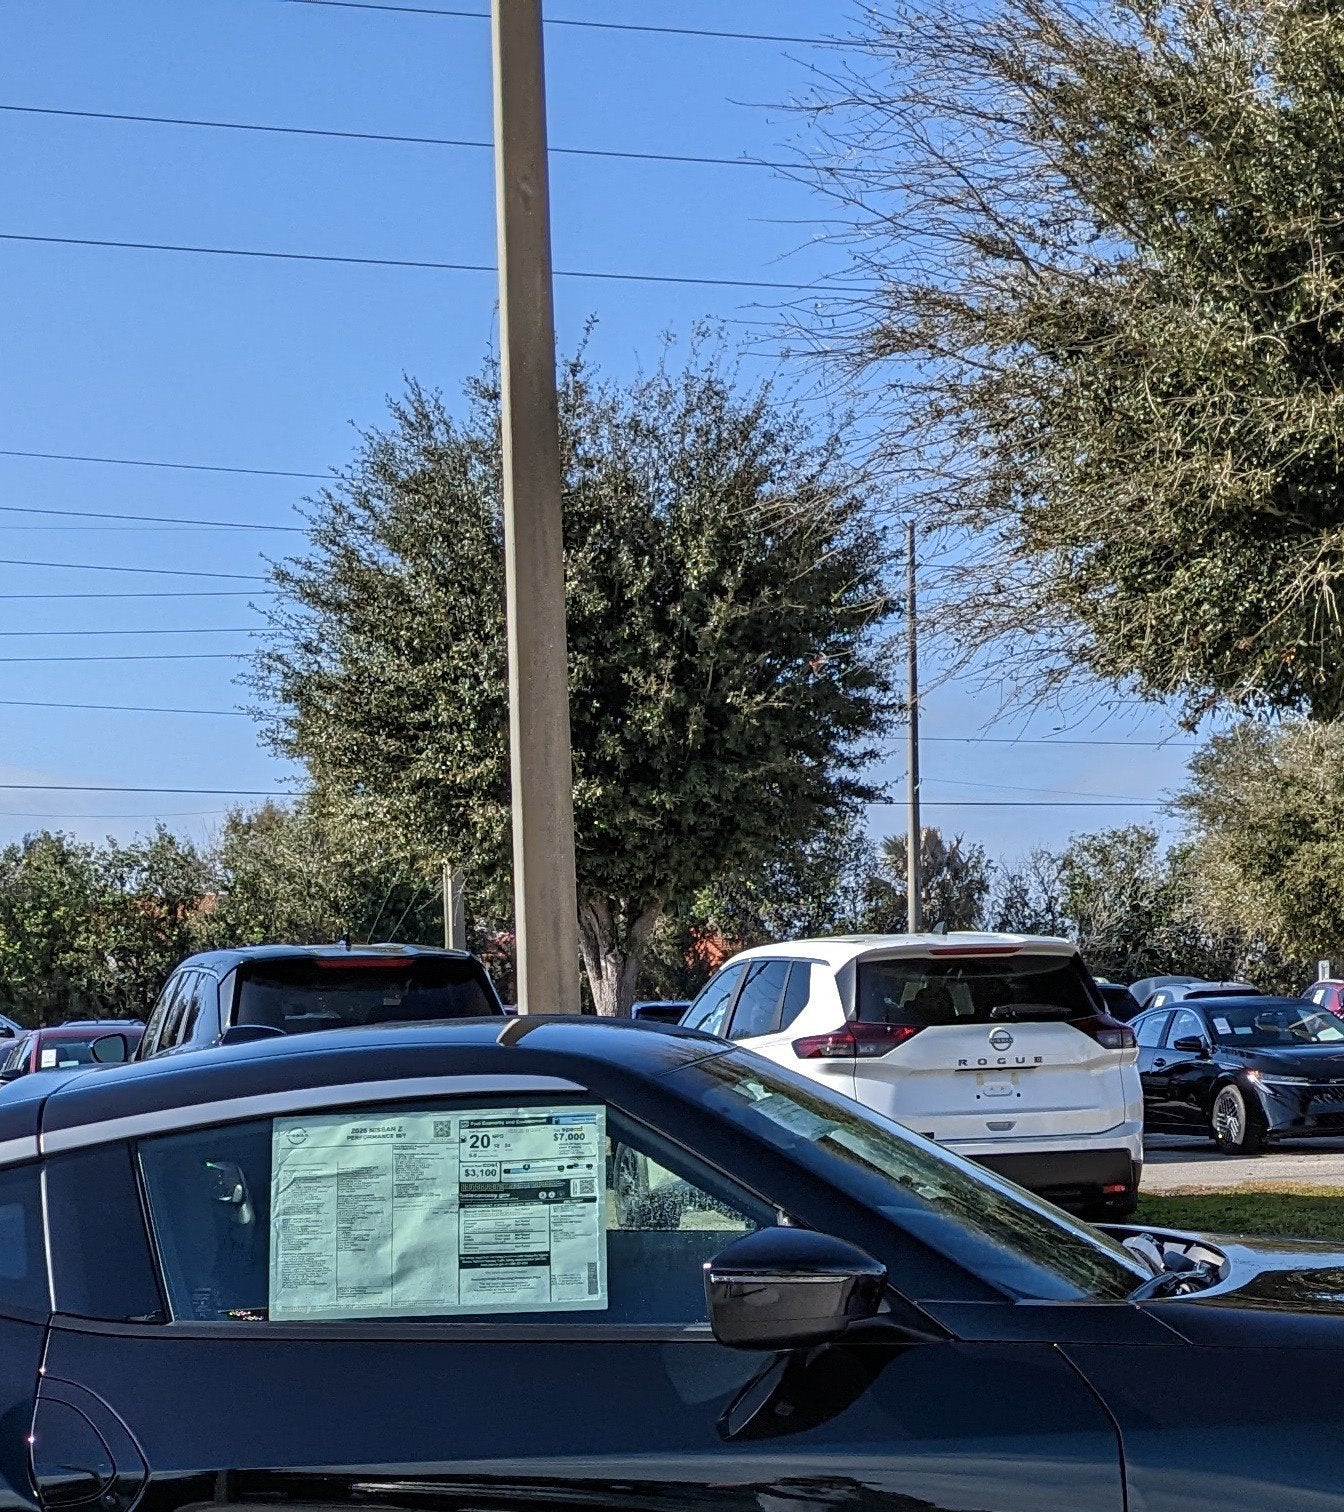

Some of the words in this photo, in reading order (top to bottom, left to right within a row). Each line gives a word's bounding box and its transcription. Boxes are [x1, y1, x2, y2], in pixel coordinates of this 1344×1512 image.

[958, 1056, 1042, 1066] ROGUE
[469, 1134, 491, 1148] 20
[553, 1132, 585, 1141] $7,000
[464, 1169, 497, 1177] $3,100
